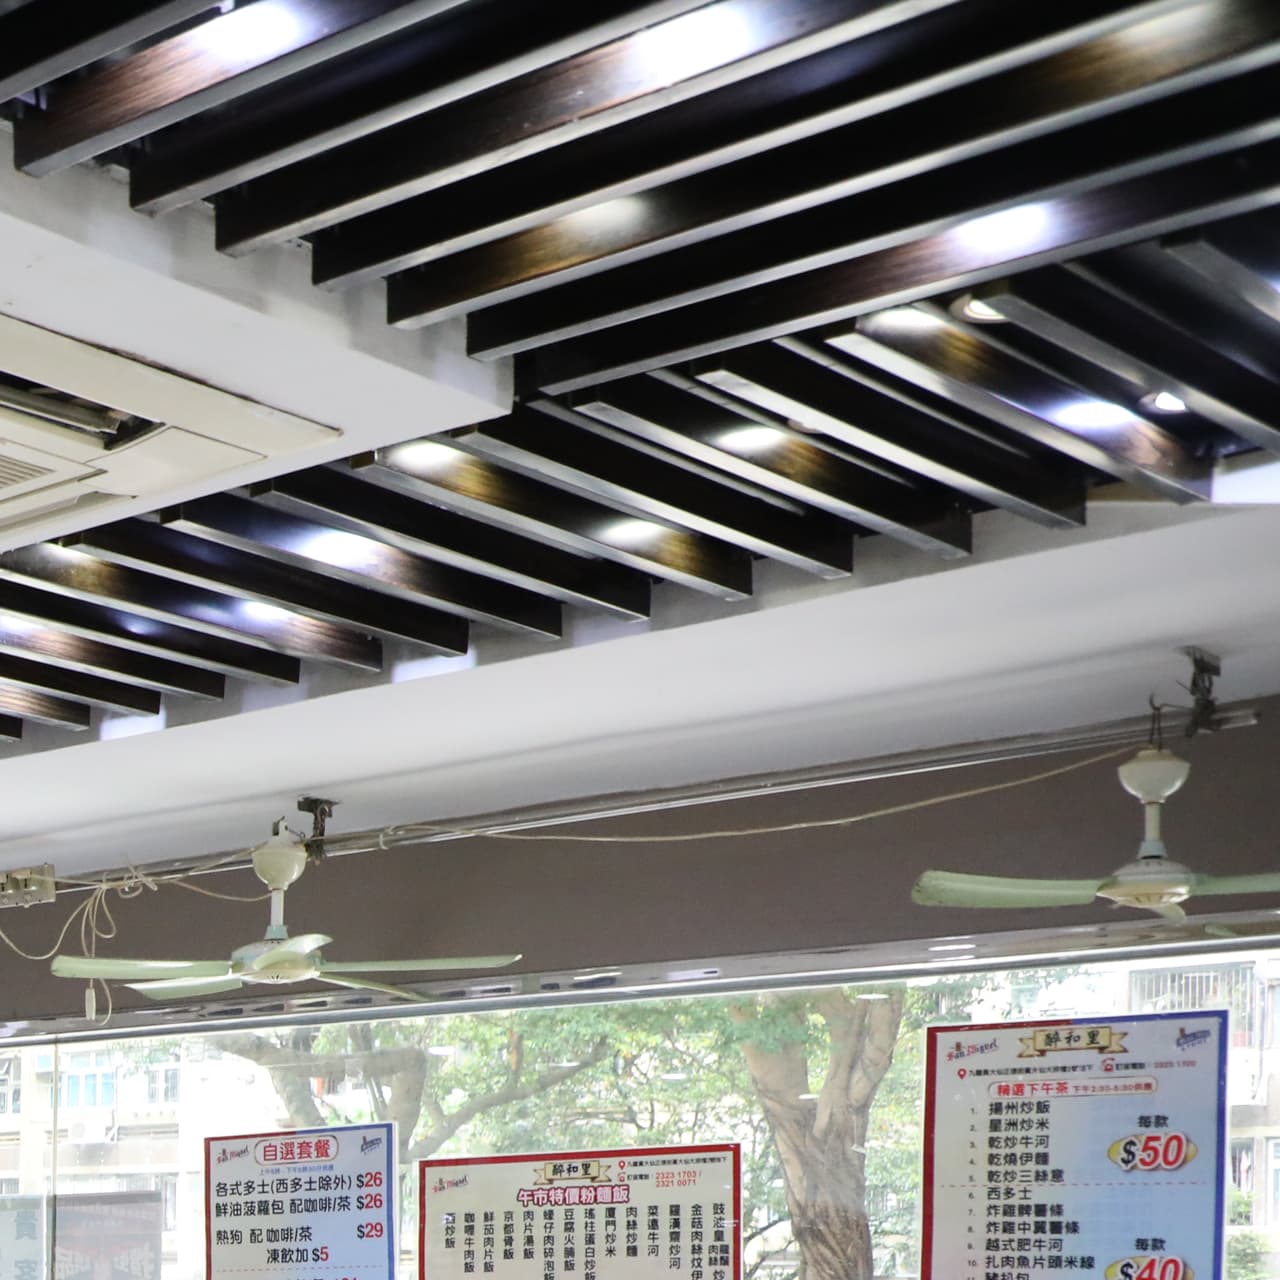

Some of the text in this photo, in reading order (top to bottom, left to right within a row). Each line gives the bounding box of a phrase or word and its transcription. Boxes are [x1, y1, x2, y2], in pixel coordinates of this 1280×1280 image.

[264, 1139, 331, 1161] 自選套餐
[1120, 1134, 1185, 1166] $50
[216, 1171, 383, 1197] 各式多士(西多士除外) $26
[987, 1187, 1032, 1201] 西多士
[215, 1199, 285, 1218] 鮮油菠蘿包
[356, 1194, 383, 1210] $26
[216, 1229, 242, 1245] 熱狗
[357, 1223, 383, 1239] $29
